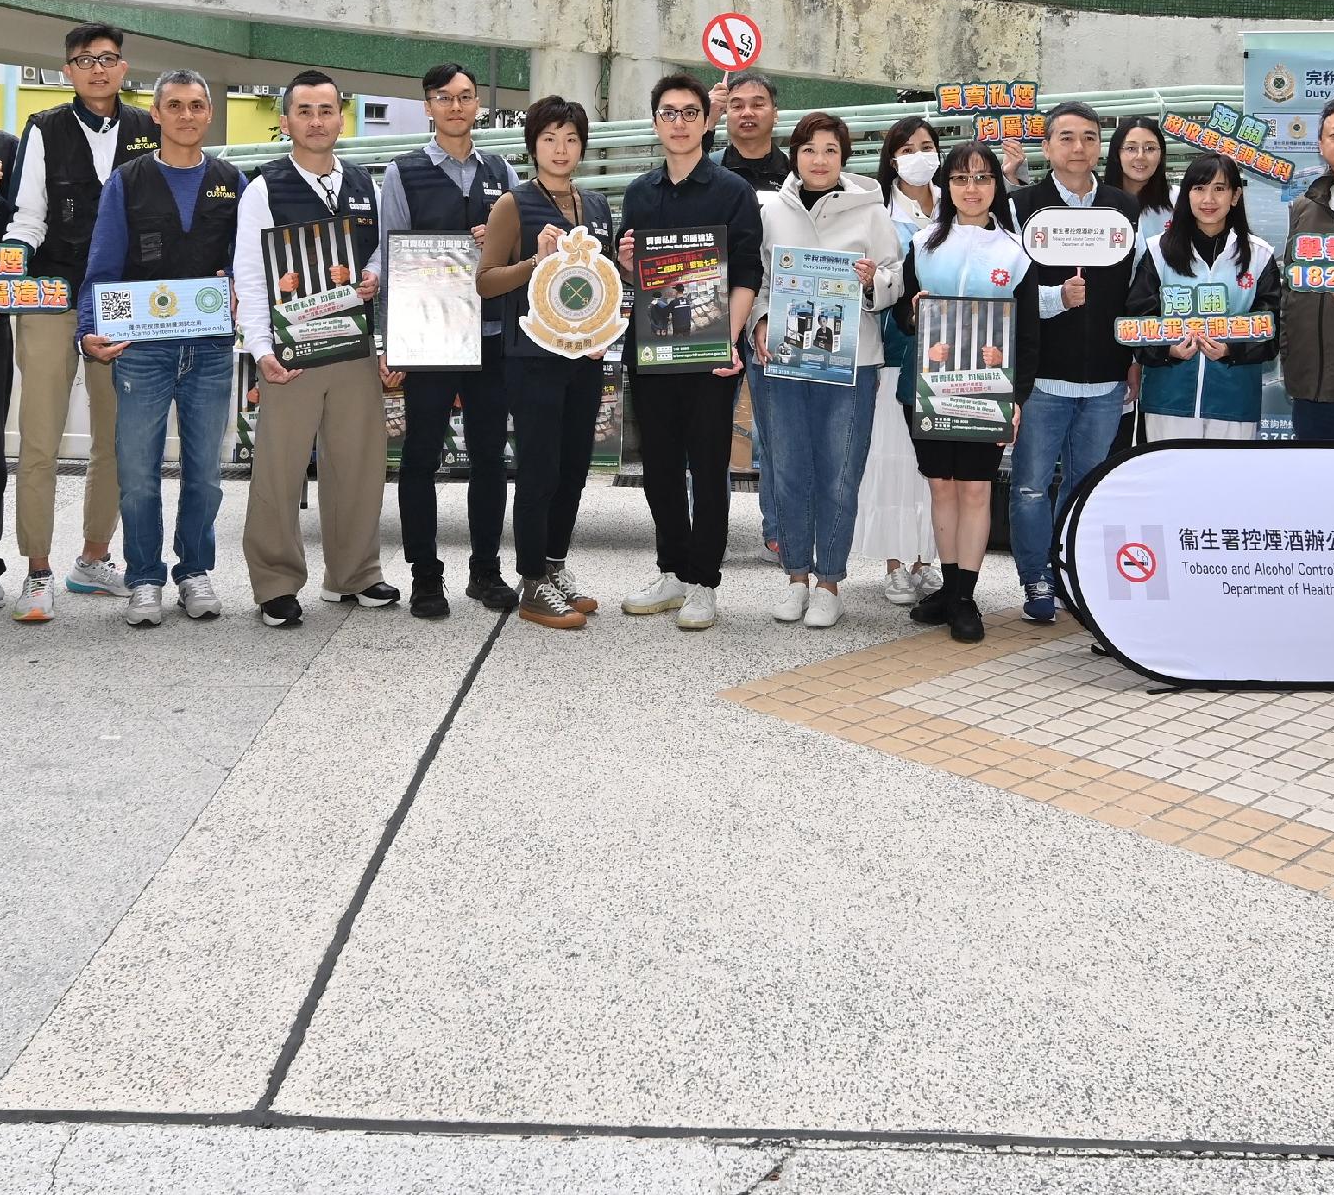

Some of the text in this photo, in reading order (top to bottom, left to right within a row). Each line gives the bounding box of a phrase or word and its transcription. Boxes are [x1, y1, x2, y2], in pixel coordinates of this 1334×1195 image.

[940, 84, 1036, 110] 買賣私煙
[1306, 89, 1330, 99] Duty
[976, 115, 1046, 141] 均屬違
[1210, 105, 1269, 145] 海關
[126, 142, 158, 151] CUSTOMS
[206, 190, 236, 199] CUSTOMS
[1164, 286, 1227, 314] 海關
[1182, 561, 1229, 576] Tobacco
[1232, 562, 1250, 576] and
[1254, 562, 1294, 577] Alcohol
[1222, 582, 1285, 598] Department
[1288, 582, 1300, 596] of
